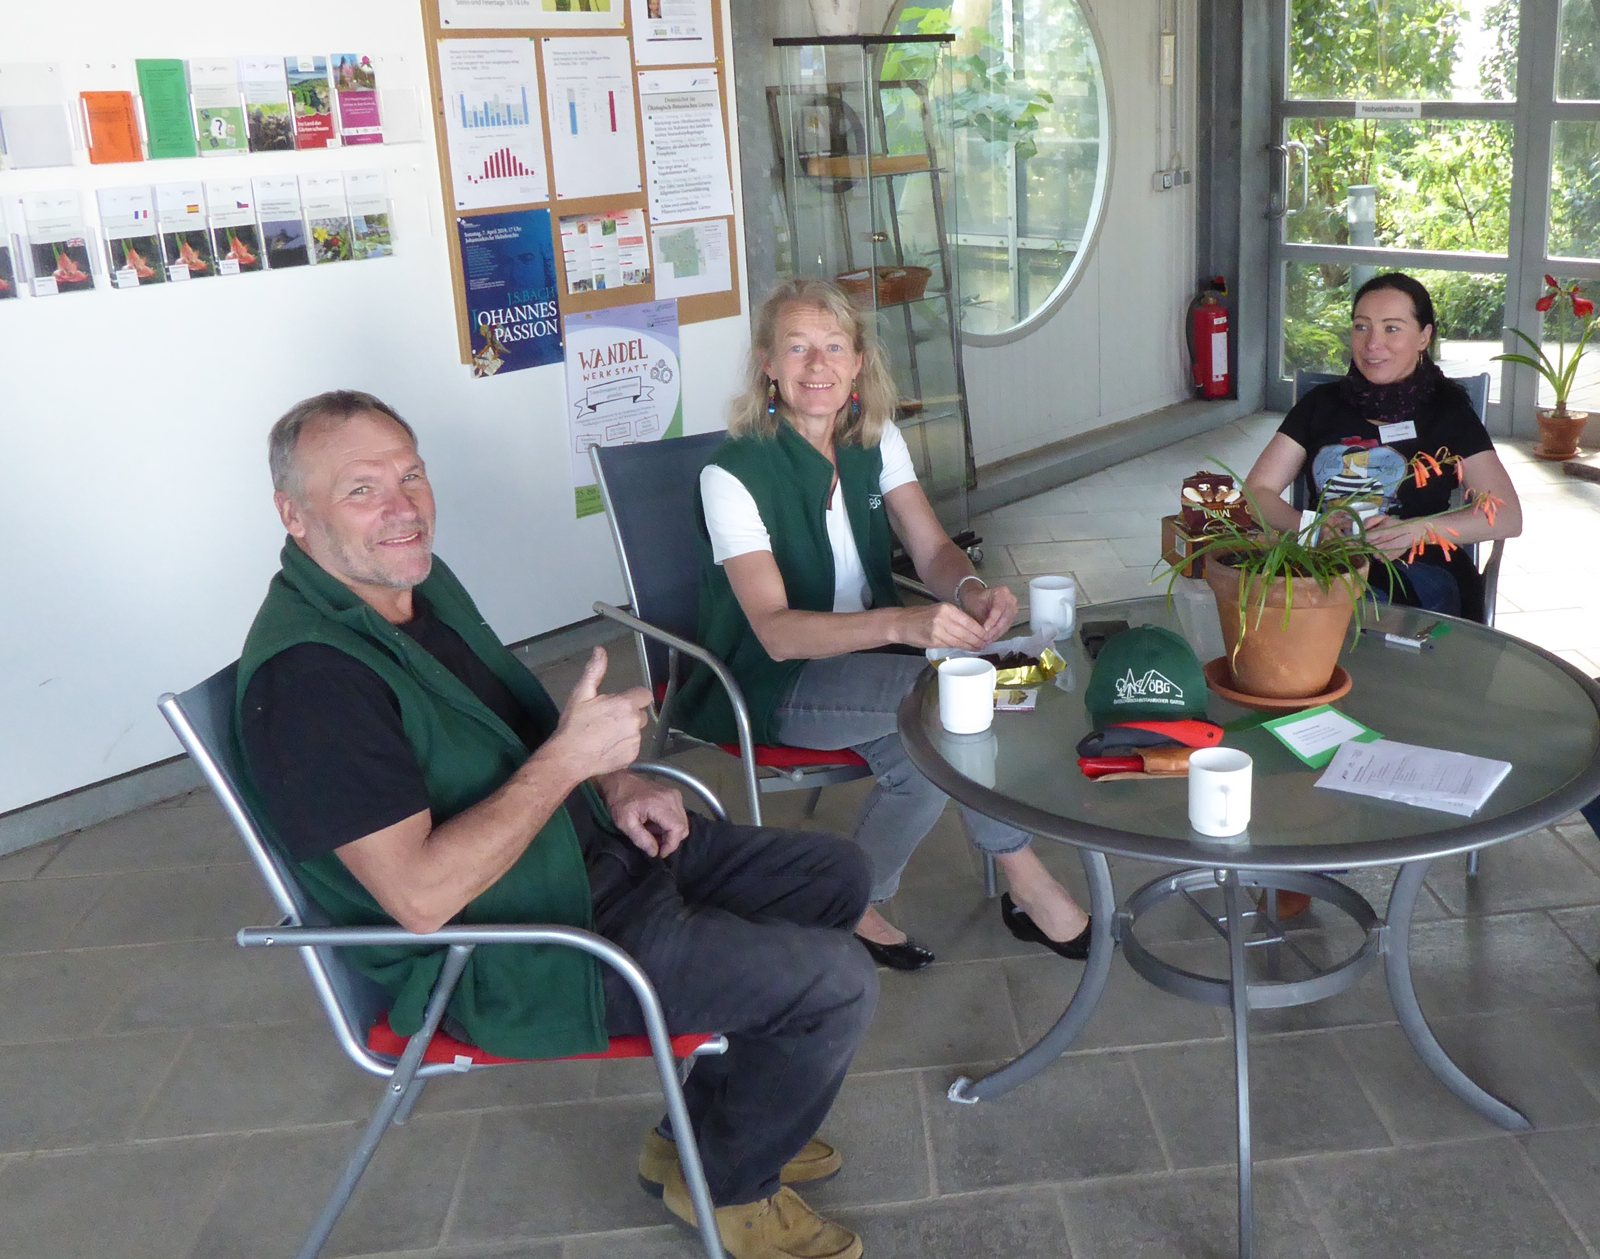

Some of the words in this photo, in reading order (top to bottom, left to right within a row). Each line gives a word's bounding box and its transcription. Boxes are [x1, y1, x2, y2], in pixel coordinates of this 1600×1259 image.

[494, 319, 558, 343] PASSION
[578, 338, 649, 370] WANDEL
[583, 363, 648, 381] WERKSTATT
[1148, 679, 1170, 694] ÖBG
